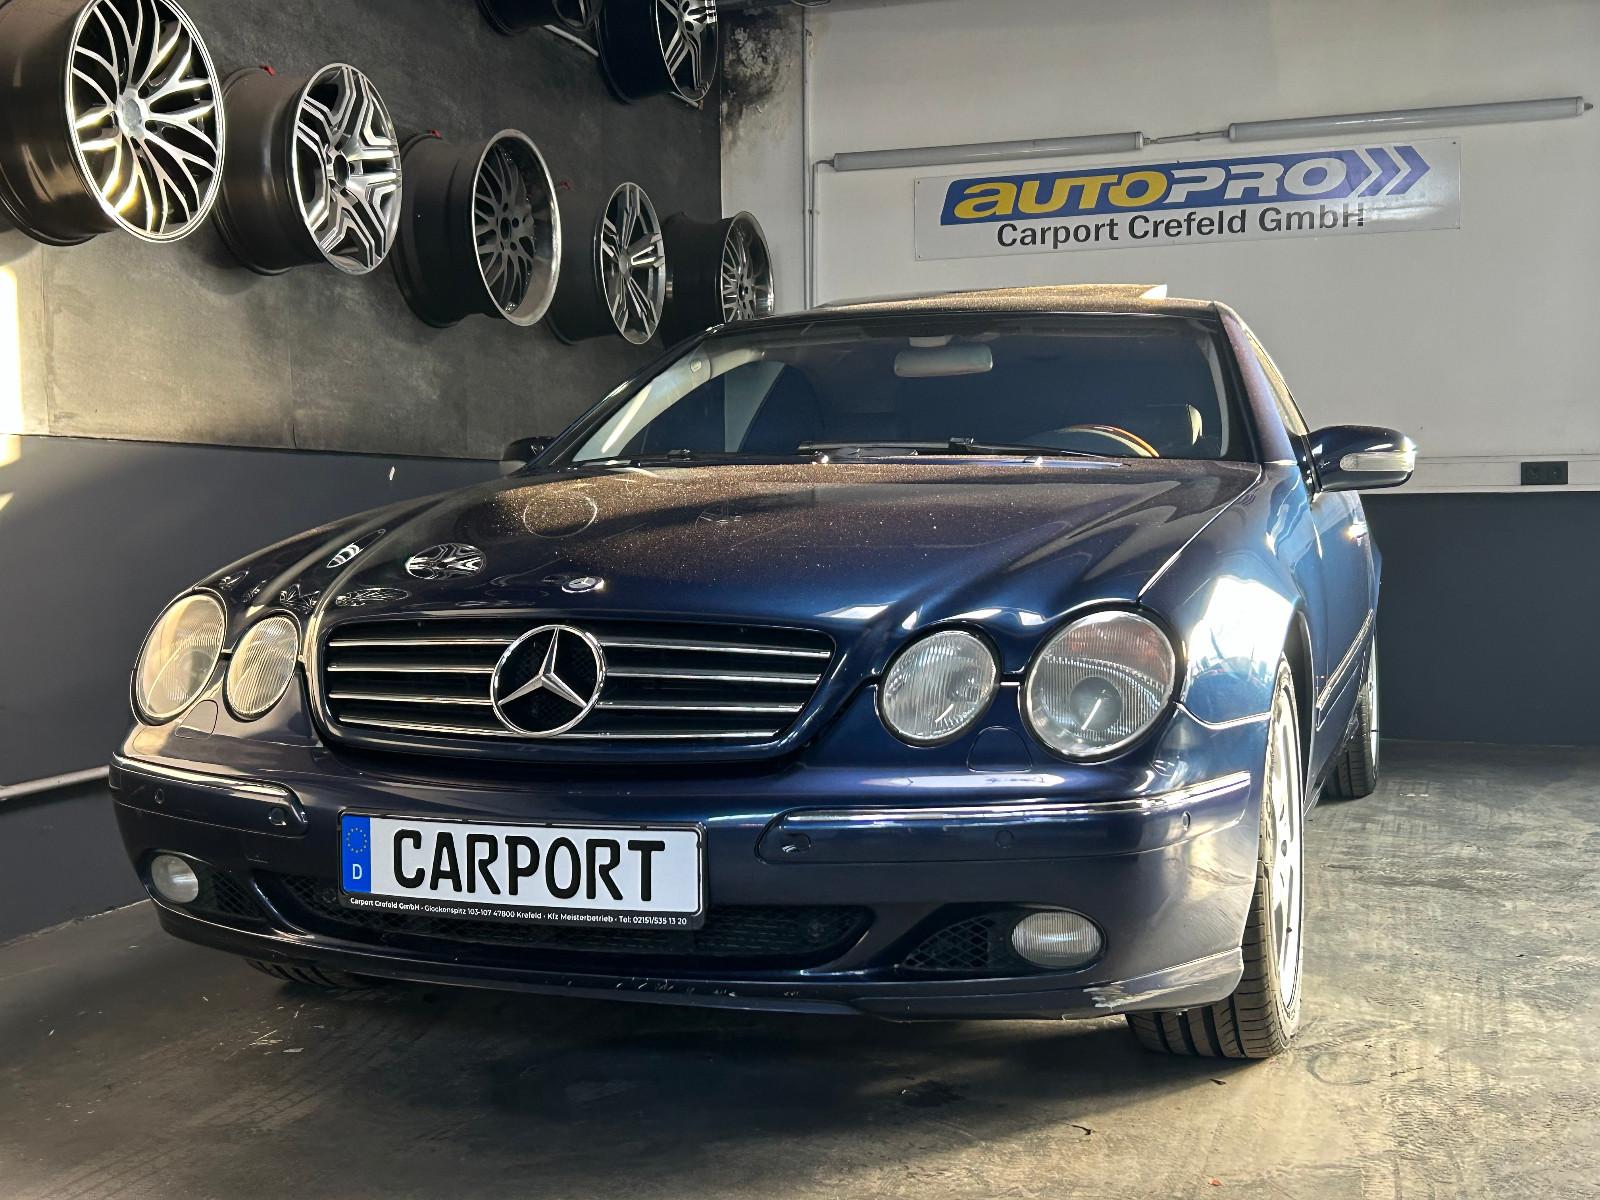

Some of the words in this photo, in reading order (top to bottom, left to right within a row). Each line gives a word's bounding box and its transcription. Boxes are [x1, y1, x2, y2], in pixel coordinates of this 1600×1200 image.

[997, 218, 1119, 250] Carport
[1128, 209, 1247, 240] Crefeld
[1258, 202, 1364, 232] GmbH
[351, 863, 363, 881] D
[393, 828, 666, 902] CARPORT
[350, 897, 374, 906] Carport
[374, 900, 398, 909] Crefeld
[399, 903, 420, 911] GmbH
[467, 908, 492, 916] 103-107
[493, 910, 516, 918] 47800
[516, 911, 542, 919] Krefeld
[547, 912, 559, 920] Kfz
[560, 913, 614, 923] Meisterbetrieb
[632, 916, 667, 925] 02151/535
[668, 917, 676, 925] 13
[677, 917, 687, 925] 20
